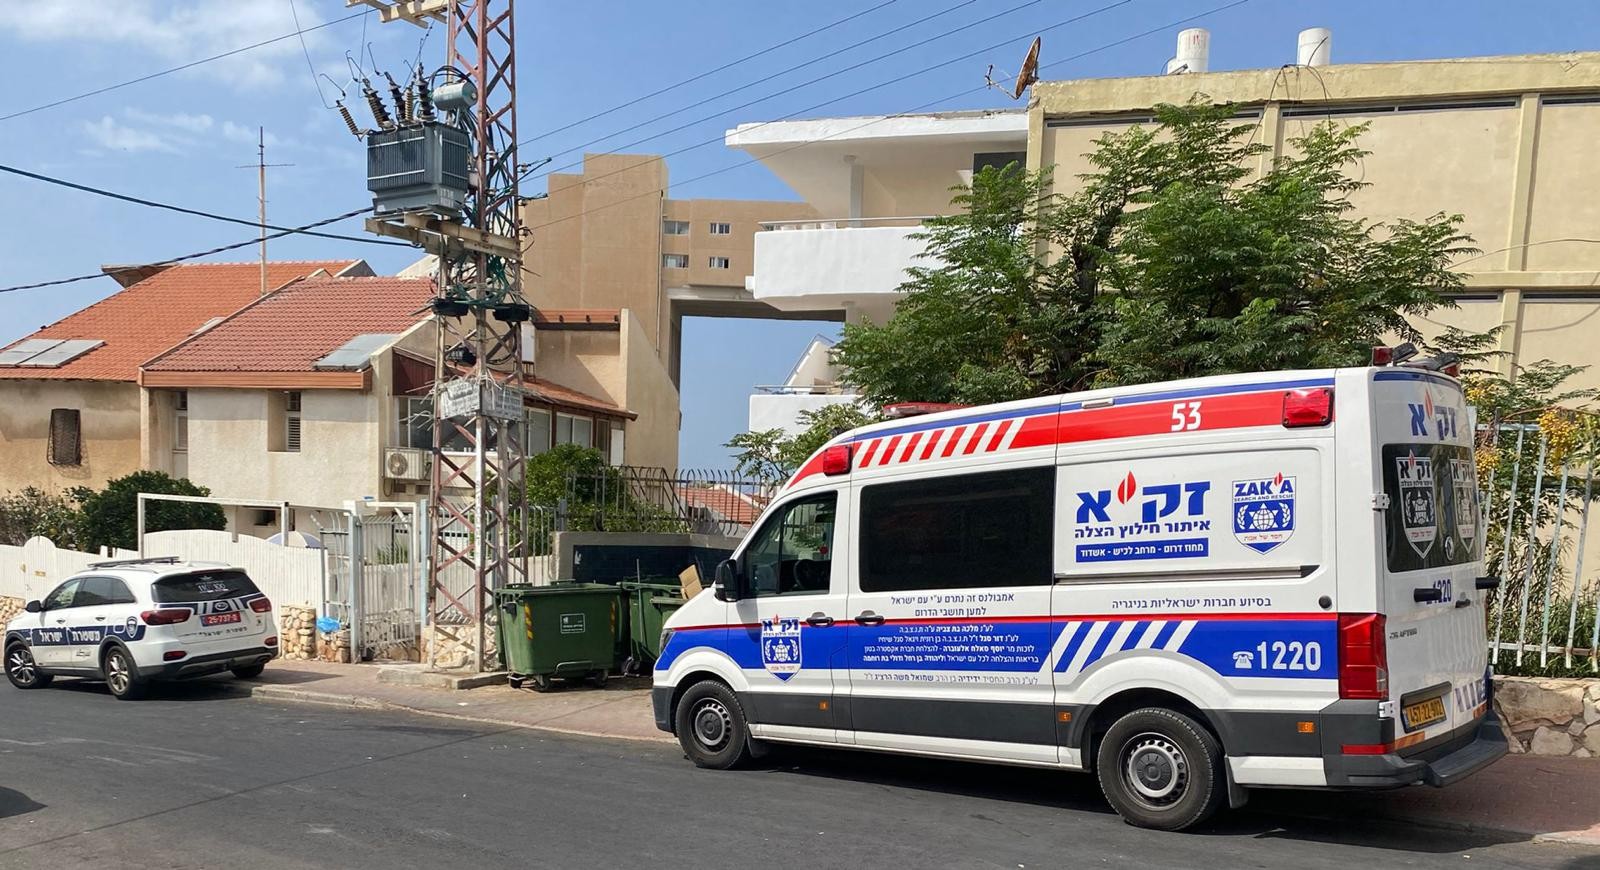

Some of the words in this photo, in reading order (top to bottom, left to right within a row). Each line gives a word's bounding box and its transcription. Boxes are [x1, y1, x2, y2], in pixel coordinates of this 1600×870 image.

[1171, 402, 1201, 431] 53
[1118, 522, 1160, 538] חילוץ
[1164, 520, 1210, 533] איתור
[1075, 526, 1114, 538] הצלה
[1113, 546, 1133, 555] לכיש
[1135, 546, 1156, 554] מרחב
[1164, 544, 1182, 553] דרום
[1185, 543, 1204, 552] מחוז
[1081, 548, 1105, 557] אשדוד
[891, 596, 915, 605] ישראל
[917, 596, 928, 604] עם
[930, 595, 942, 603] ע"י
[945, 595, 964, 603] נתרם
[979, 593, 1014, 602] אמבולנס
[1239, 597, 1271, 607] בסיוע
[1112, 600, 1147, 609] בניגריה
[1150, 598, 1200, 608] ישראליות
[1204, 598, 1236, 607] חברות
[915, 609, 938, 617] הדרום
[940, 608, 964, 616] תושבי
[966, 606, 987, 617] למען
[39, 629, 62, 642] ישראל
[72, 630, 101, 641] משטרת
[990, 646, 1005, 654] יוסף
[1257, 641, 1321, 671] 1220
[911, 674, 933, 682] שמואל
